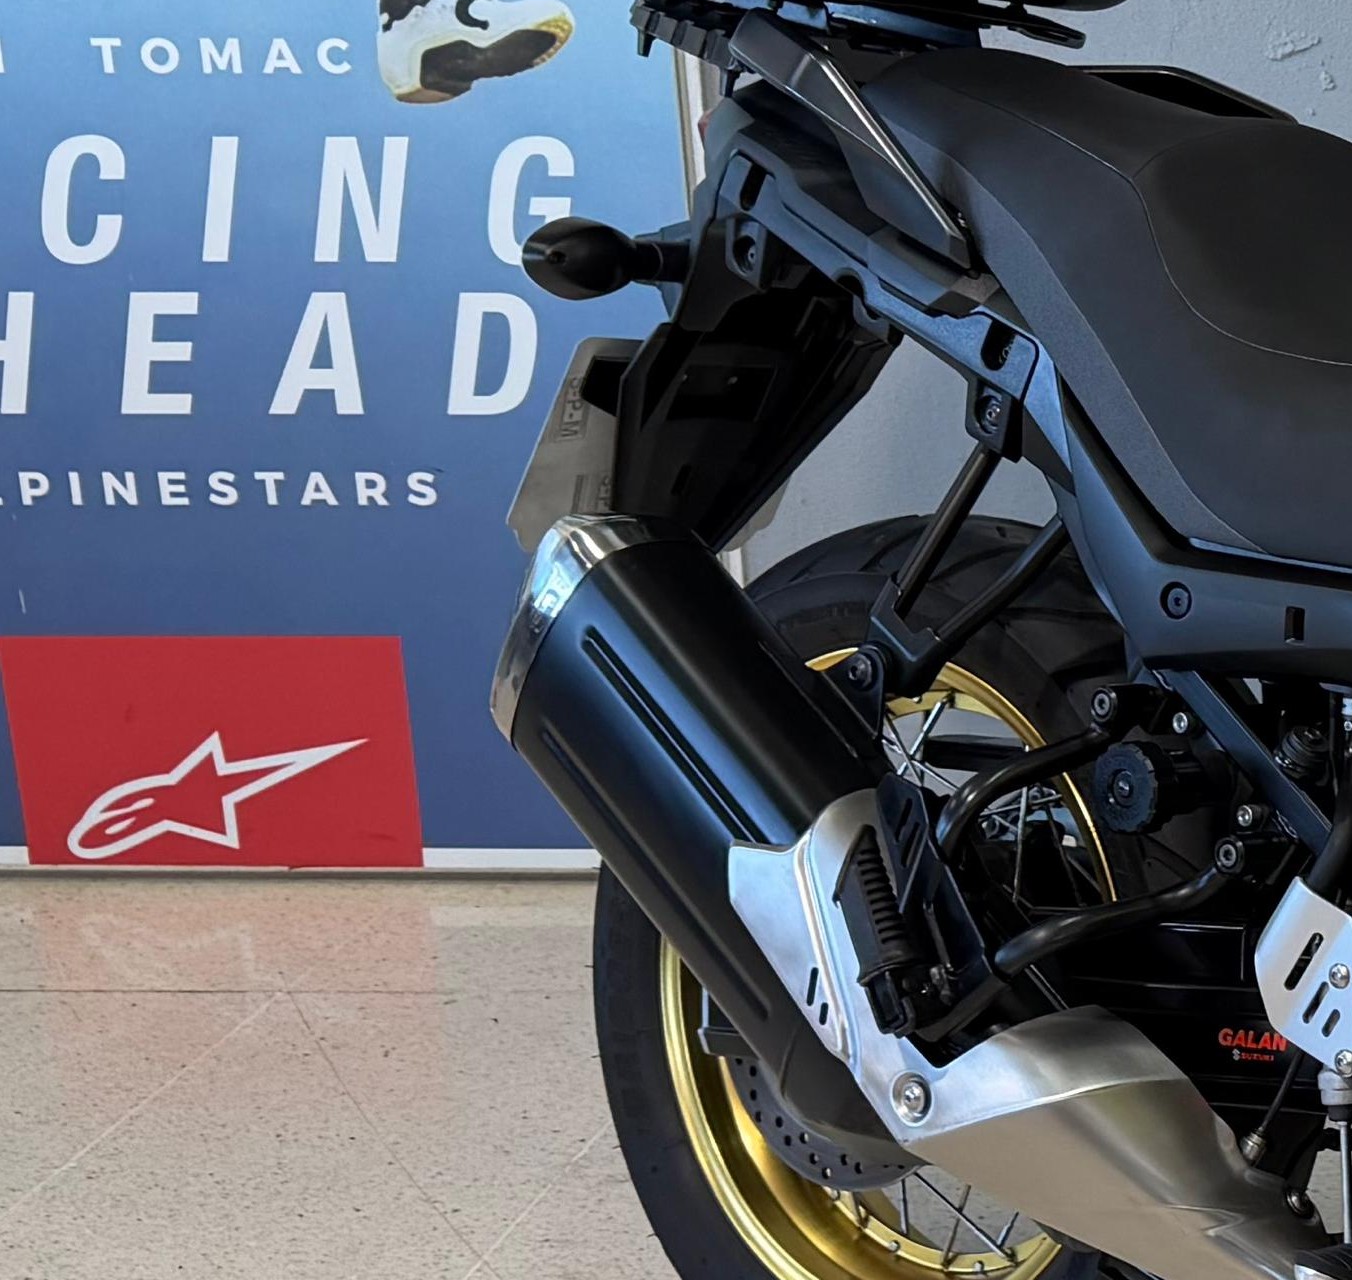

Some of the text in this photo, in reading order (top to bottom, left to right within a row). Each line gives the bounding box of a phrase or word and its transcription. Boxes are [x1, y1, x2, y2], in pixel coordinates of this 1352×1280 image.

[91, 37, 353, 74] TOMAC
[0, 470, 442, 507] PINESTARS
[1218, 1027, 1288, 1052] GALAN
